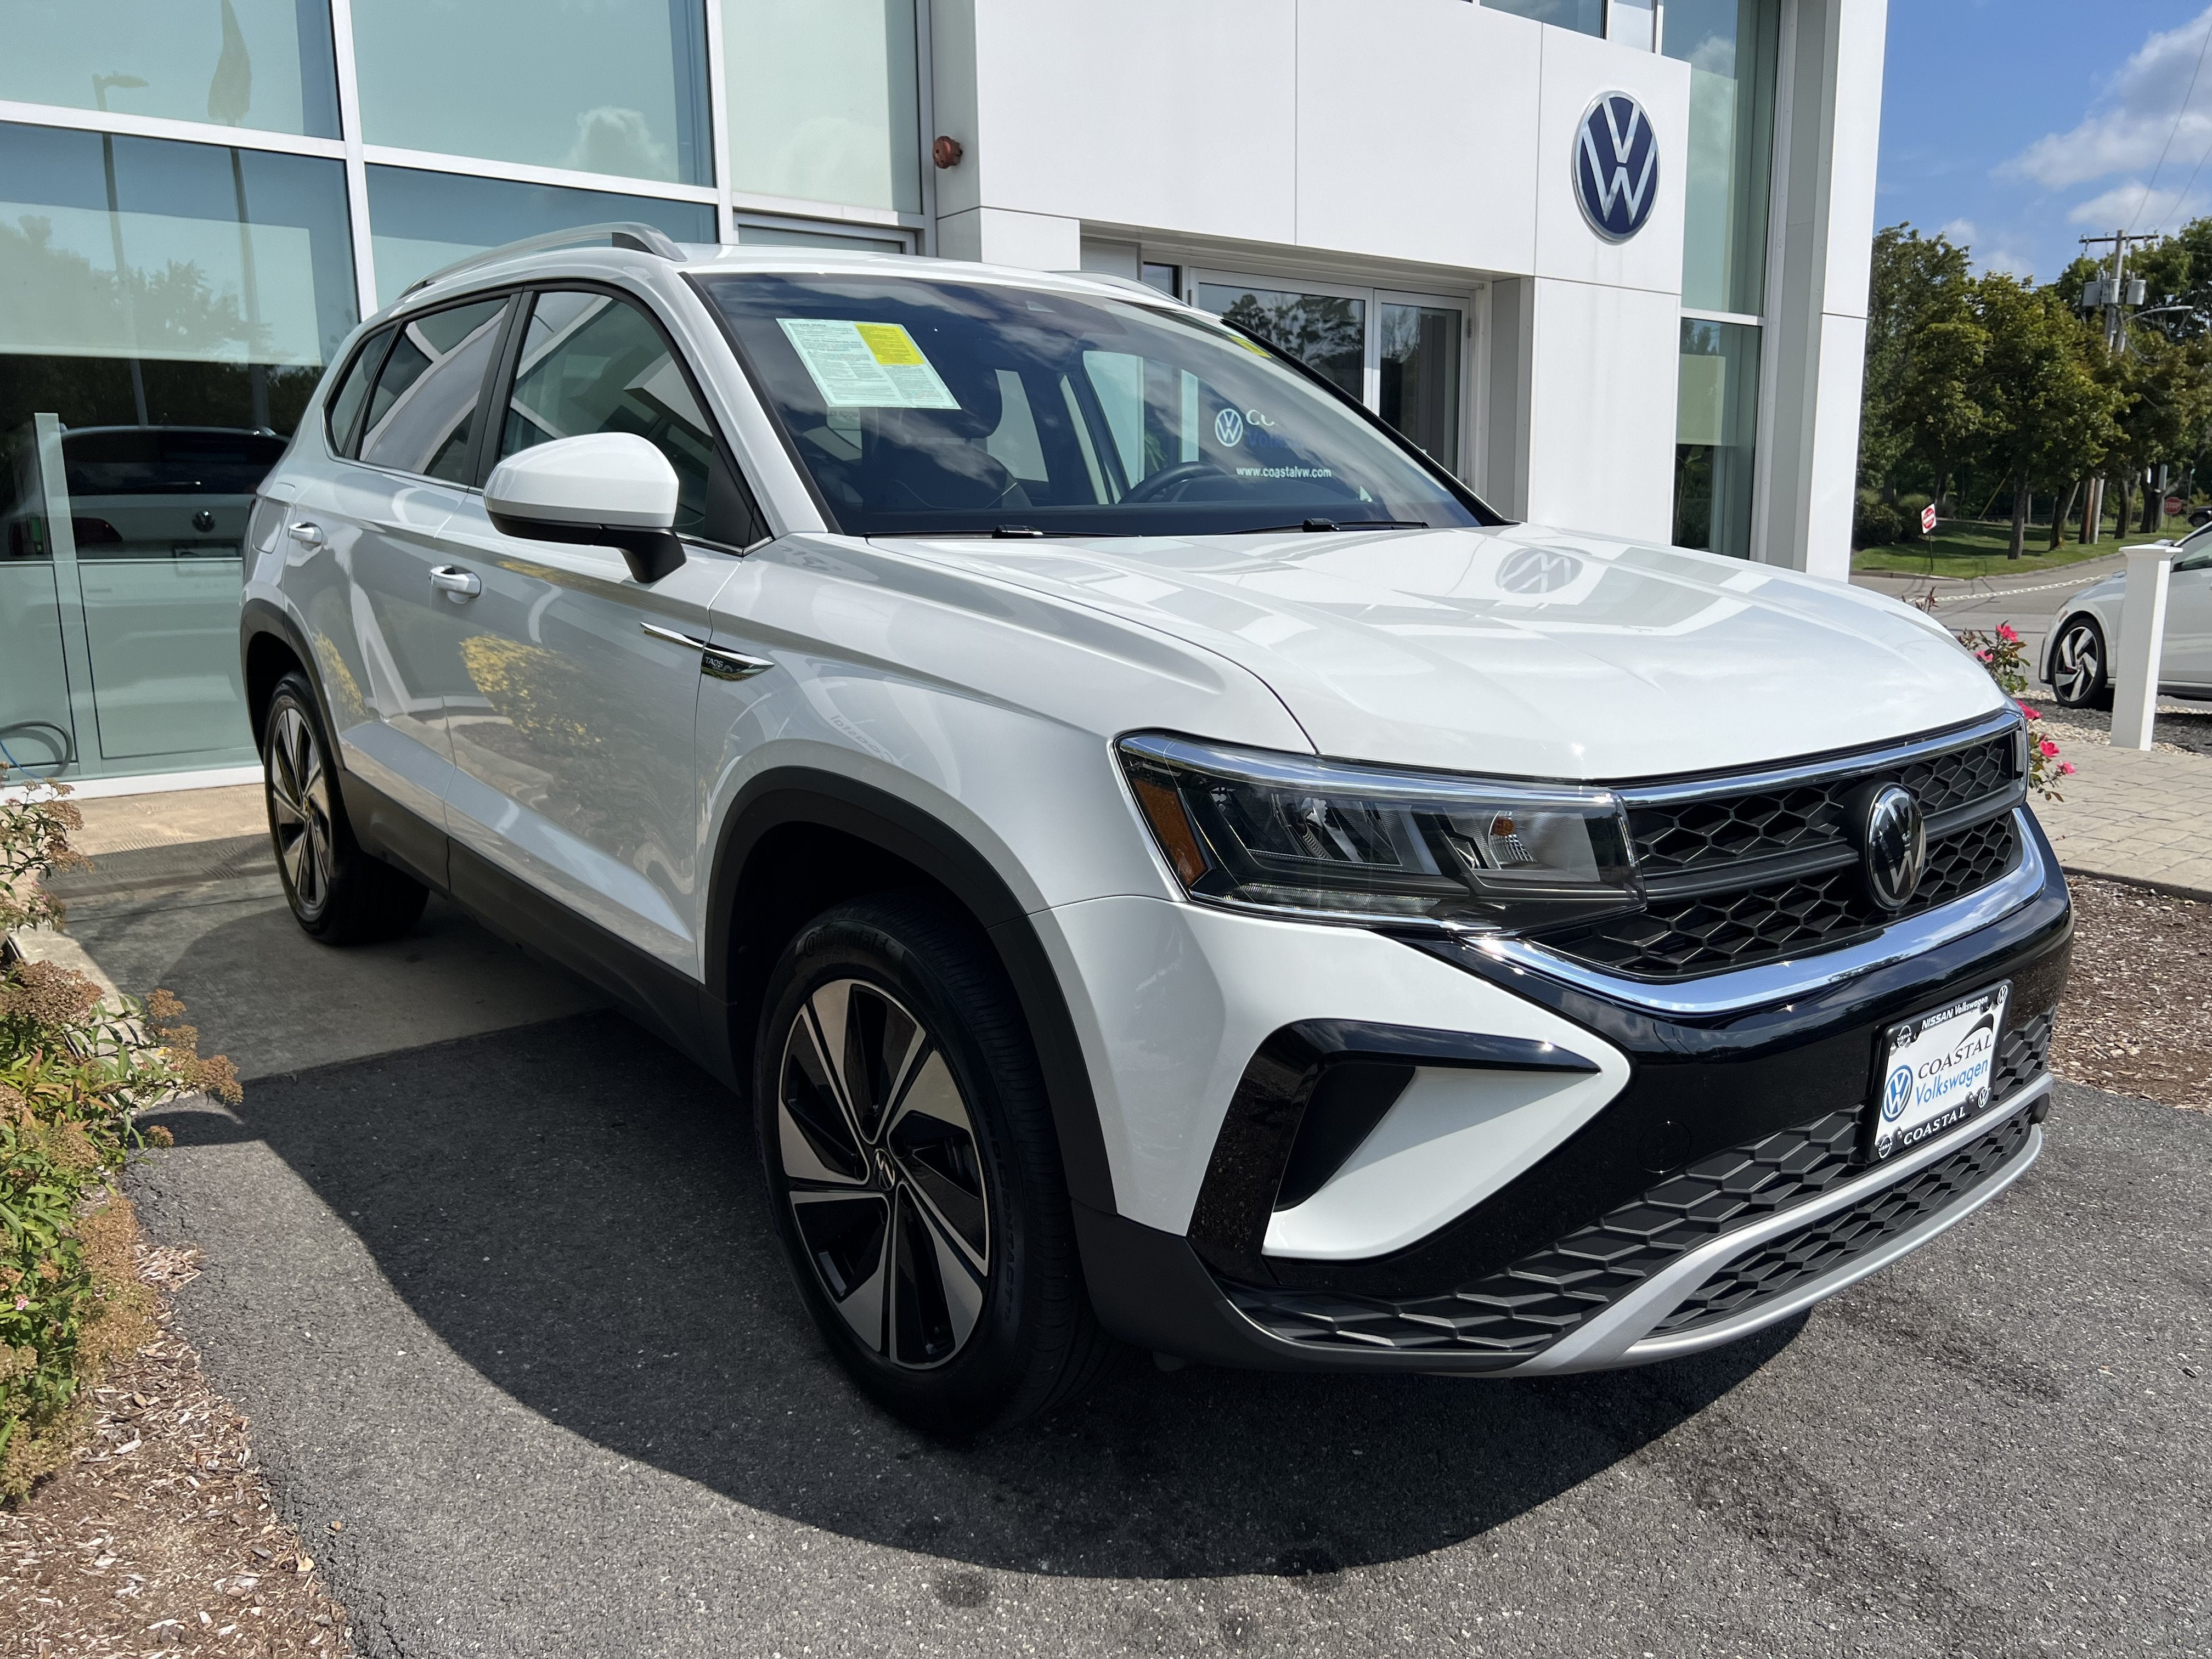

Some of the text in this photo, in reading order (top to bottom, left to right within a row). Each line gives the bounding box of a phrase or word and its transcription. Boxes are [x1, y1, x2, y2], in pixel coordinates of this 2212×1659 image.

[1236, 466, 1332, 478] www.coastalvw.com
[705, 657, 724, 668] TAOS
[1921, 996, 1988, 1030] NISSAN Volkswagen
[1918, 1034, 1992, 1079] COASTAL
[1916, 1058, 1988, 1107] Volkswagen
[1903, 1106, 1966, 1146] COASTAL
